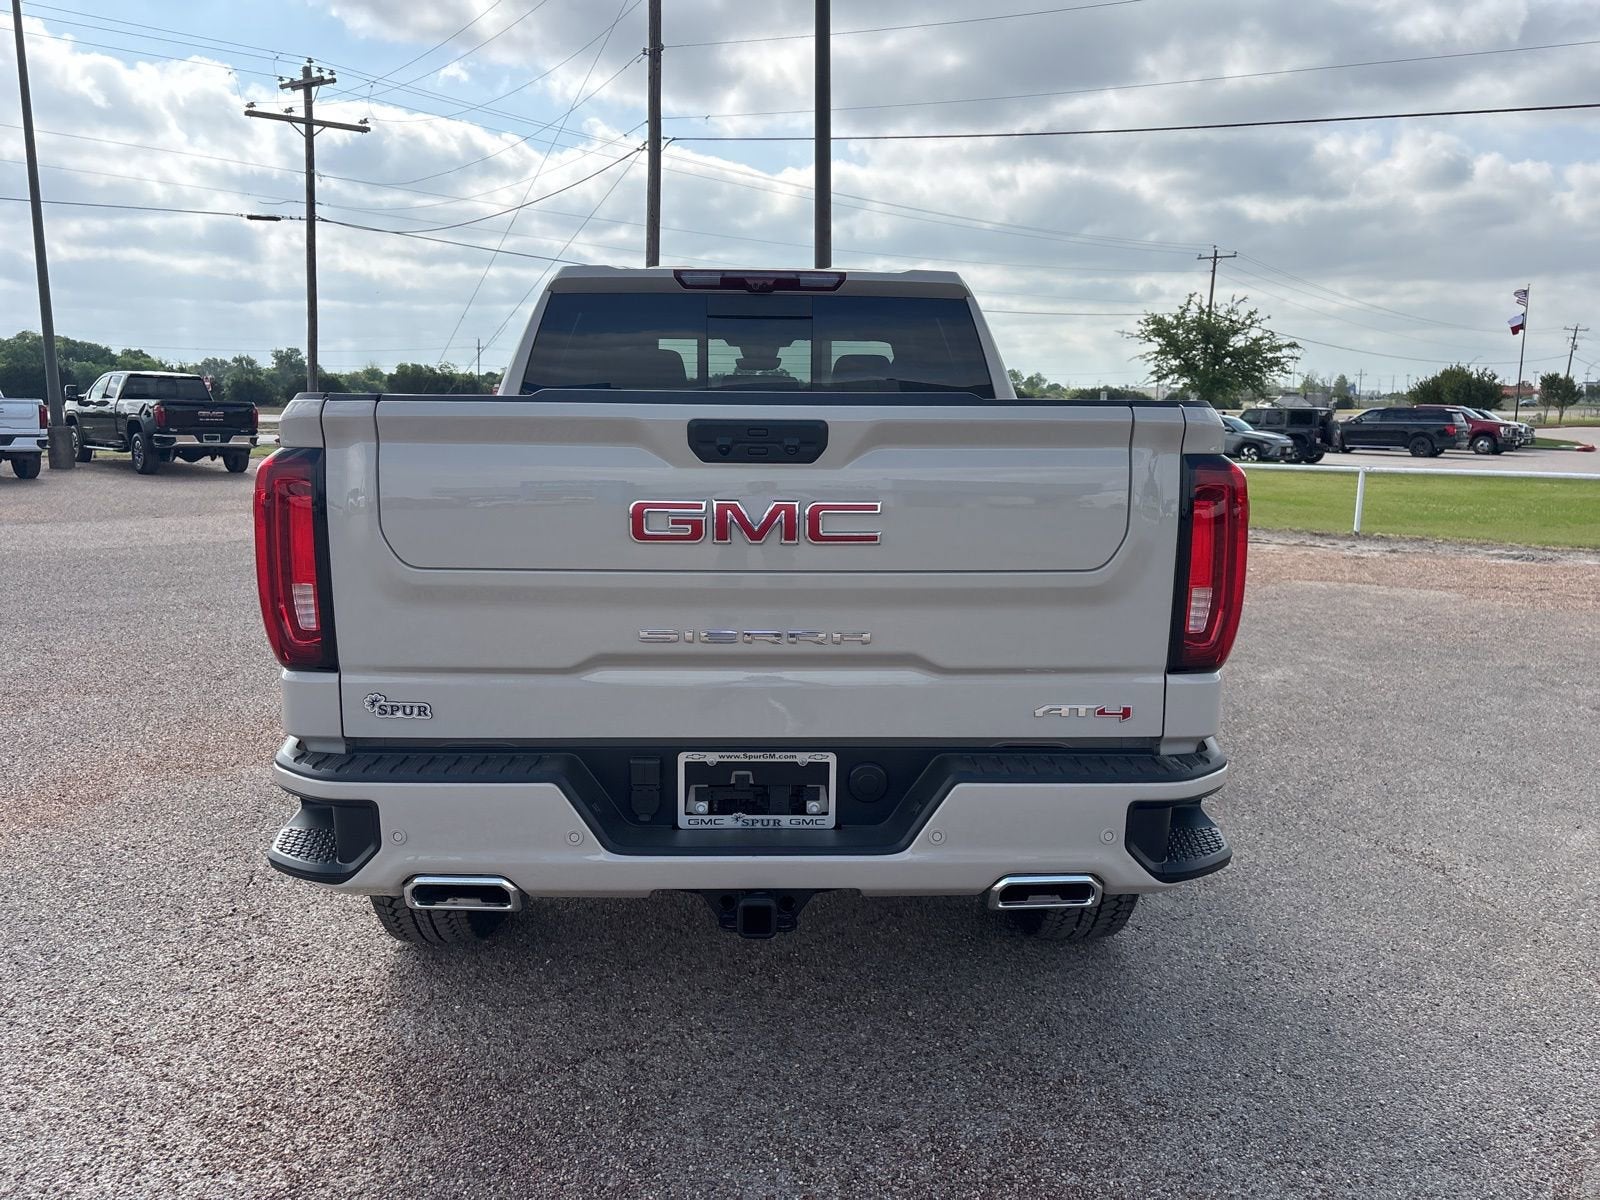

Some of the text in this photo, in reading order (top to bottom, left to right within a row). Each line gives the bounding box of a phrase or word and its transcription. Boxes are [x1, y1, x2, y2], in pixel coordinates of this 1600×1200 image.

[629, 499, 882, 545] GMC
[638, 628, 872, 645] SIERRA
[378, 704, 428, 717] SPUR
[1034, 704, 1133, 723] AT4
[718, 752, 797, 761] www.SpurGM.com
[688, 818, 826, 827] GMC SPUR GMC
